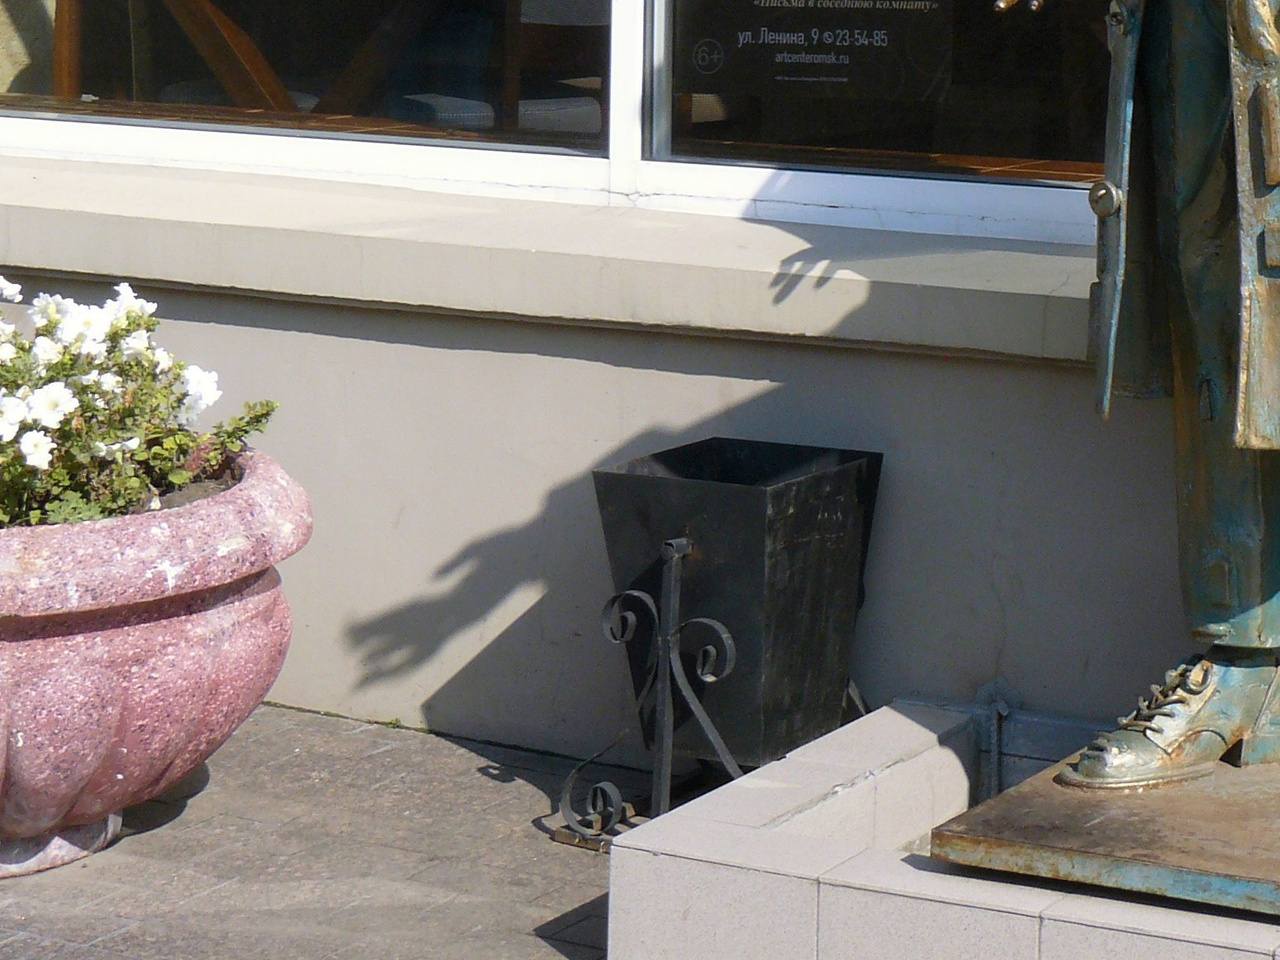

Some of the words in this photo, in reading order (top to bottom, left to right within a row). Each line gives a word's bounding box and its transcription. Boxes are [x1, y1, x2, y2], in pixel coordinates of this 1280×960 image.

[737, 31, 755, 48] ул.
[758, 27, 808, 47] Ленина,
[811, 28, 819, 44] 9
[836, 29, 888, 47] 23-54-85
